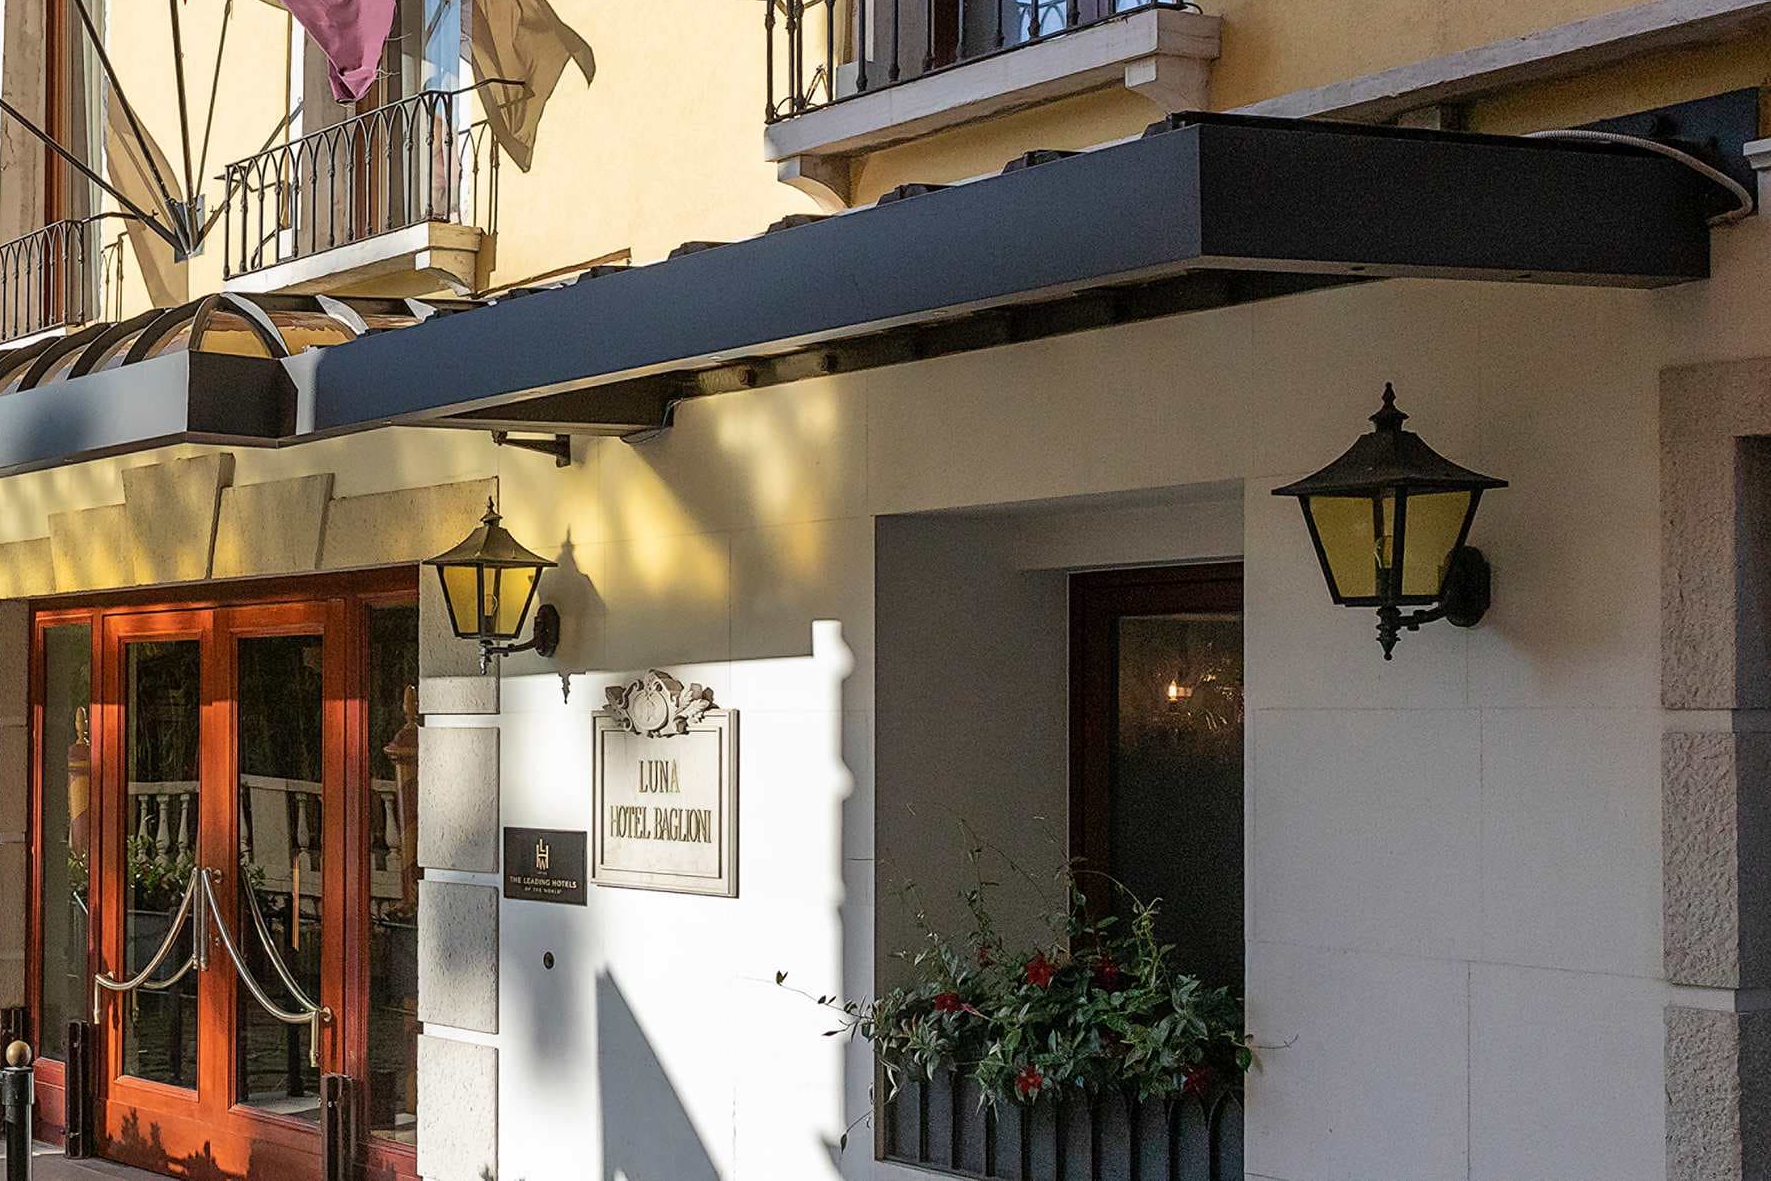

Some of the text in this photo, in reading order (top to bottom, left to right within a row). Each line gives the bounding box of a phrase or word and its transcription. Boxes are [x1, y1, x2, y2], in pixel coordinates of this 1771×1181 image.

[639, 759, 680, 793] LUNA
[610, 805, 712, 843] HOTEL BAGLIONI
[509, 875, 577, 889] THE LEADING HOTELS
